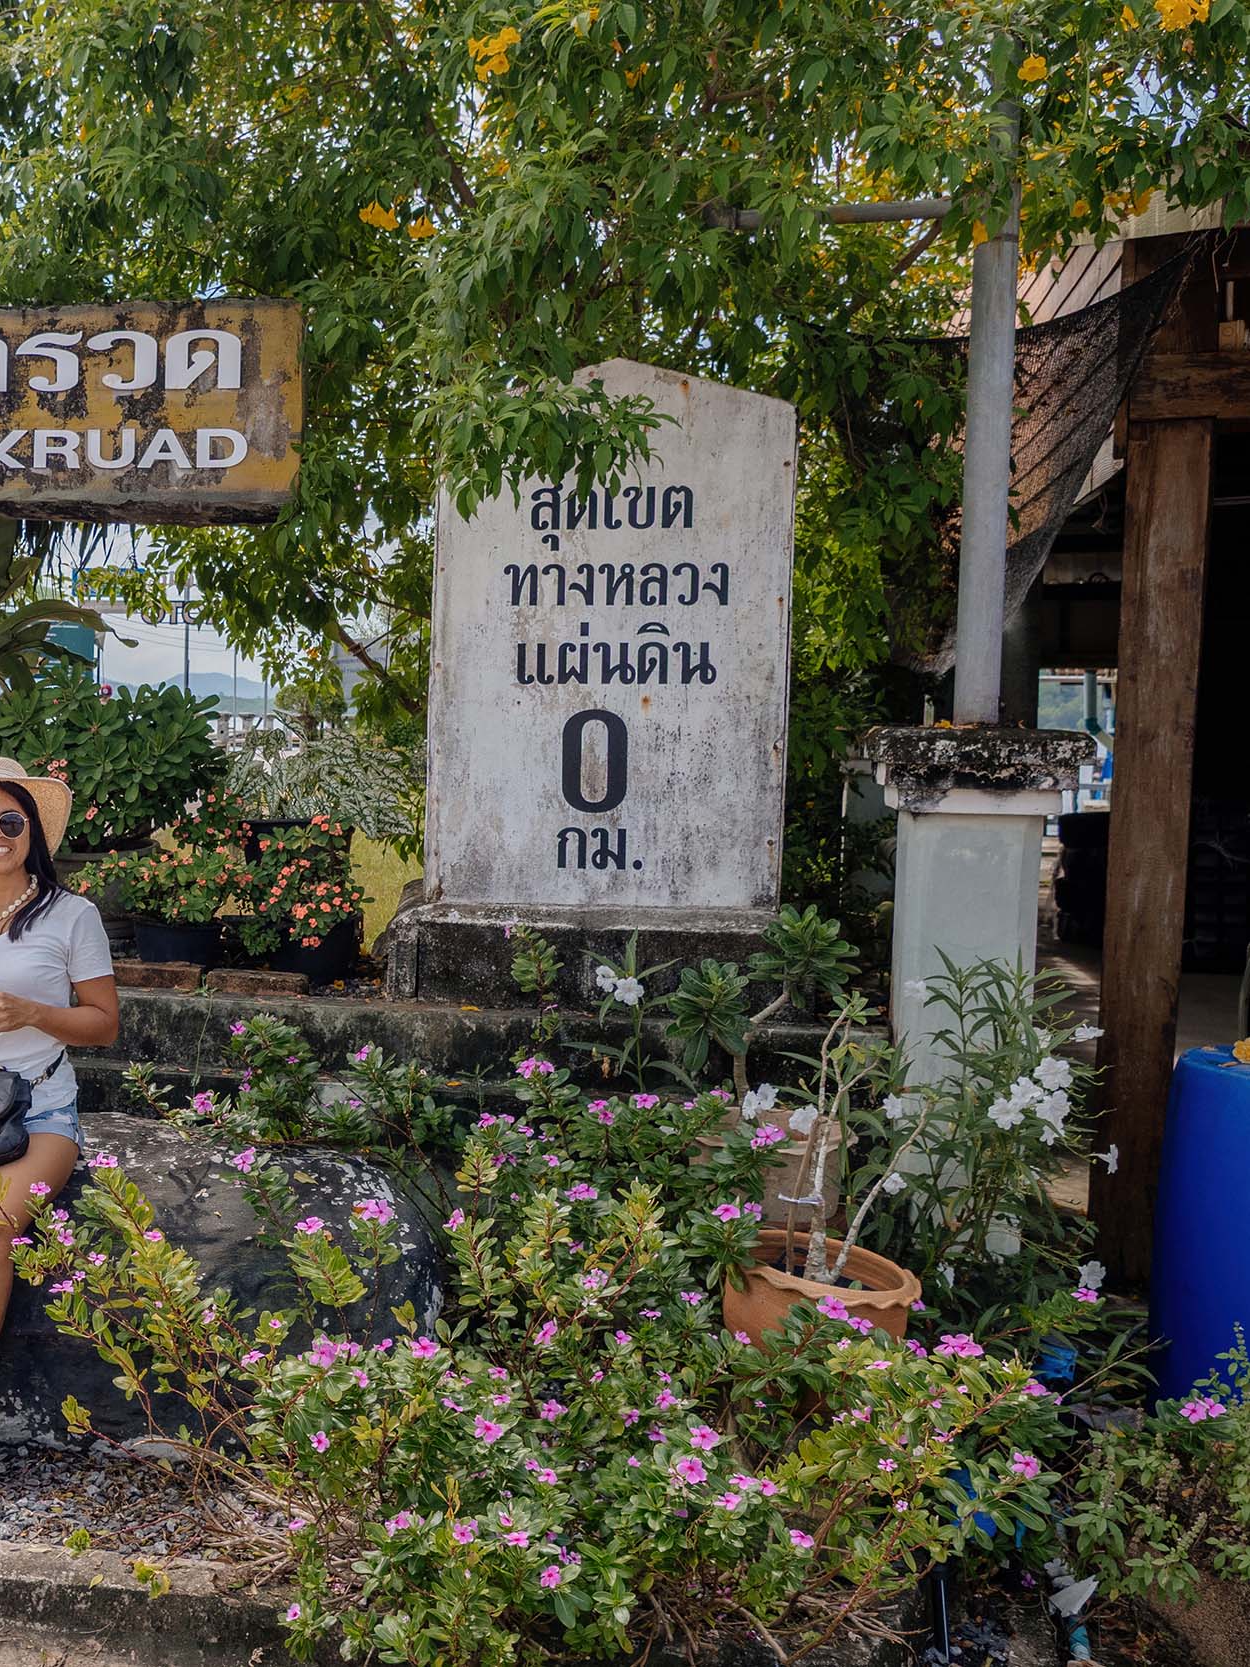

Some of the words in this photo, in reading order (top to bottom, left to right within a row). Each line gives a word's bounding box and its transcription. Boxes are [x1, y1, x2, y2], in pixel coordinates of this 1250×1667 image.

[530, 484, 695, 552] สุดเขต
[503, 562, 730, 607] ทางหลวง
[141, 600, 218, 625] OTO
[516, 621, 718, 686] แผ่นดิน
[561, 708, 629, 814] 0
[556, 826, 644, 872] กม.
